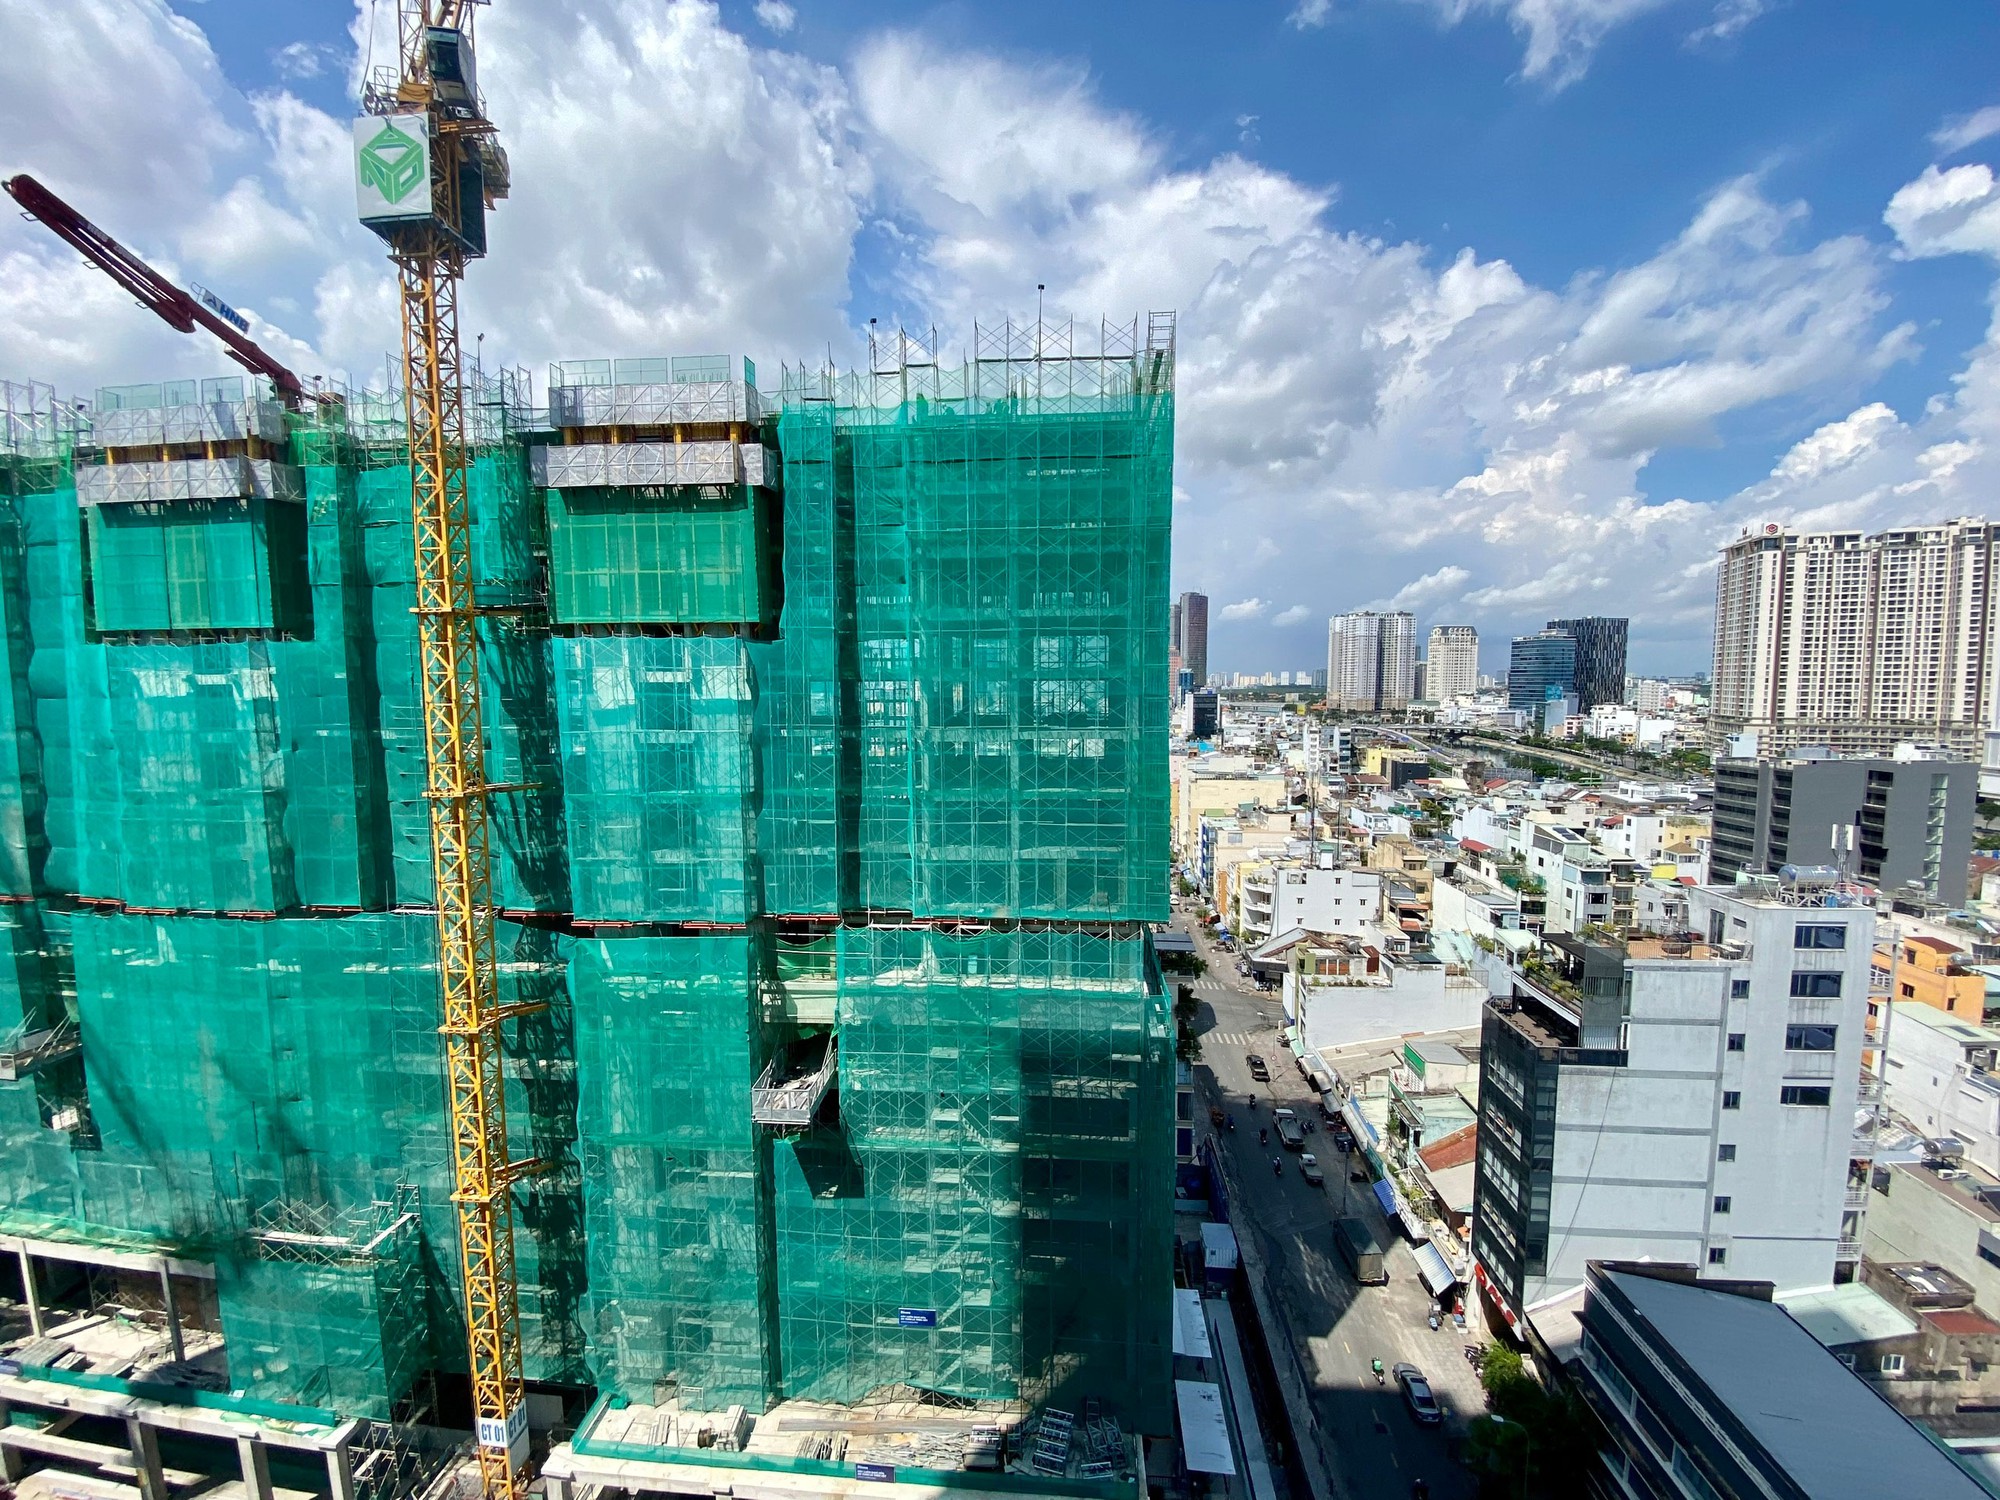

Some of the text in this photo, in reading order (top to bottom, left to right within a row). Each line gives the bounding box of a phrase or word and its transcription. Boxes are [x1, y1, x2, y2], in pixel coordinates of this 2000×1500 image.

[481, 1423, 505, 1442] CT 01
[508, 1405, 525, 1439] CT 01
